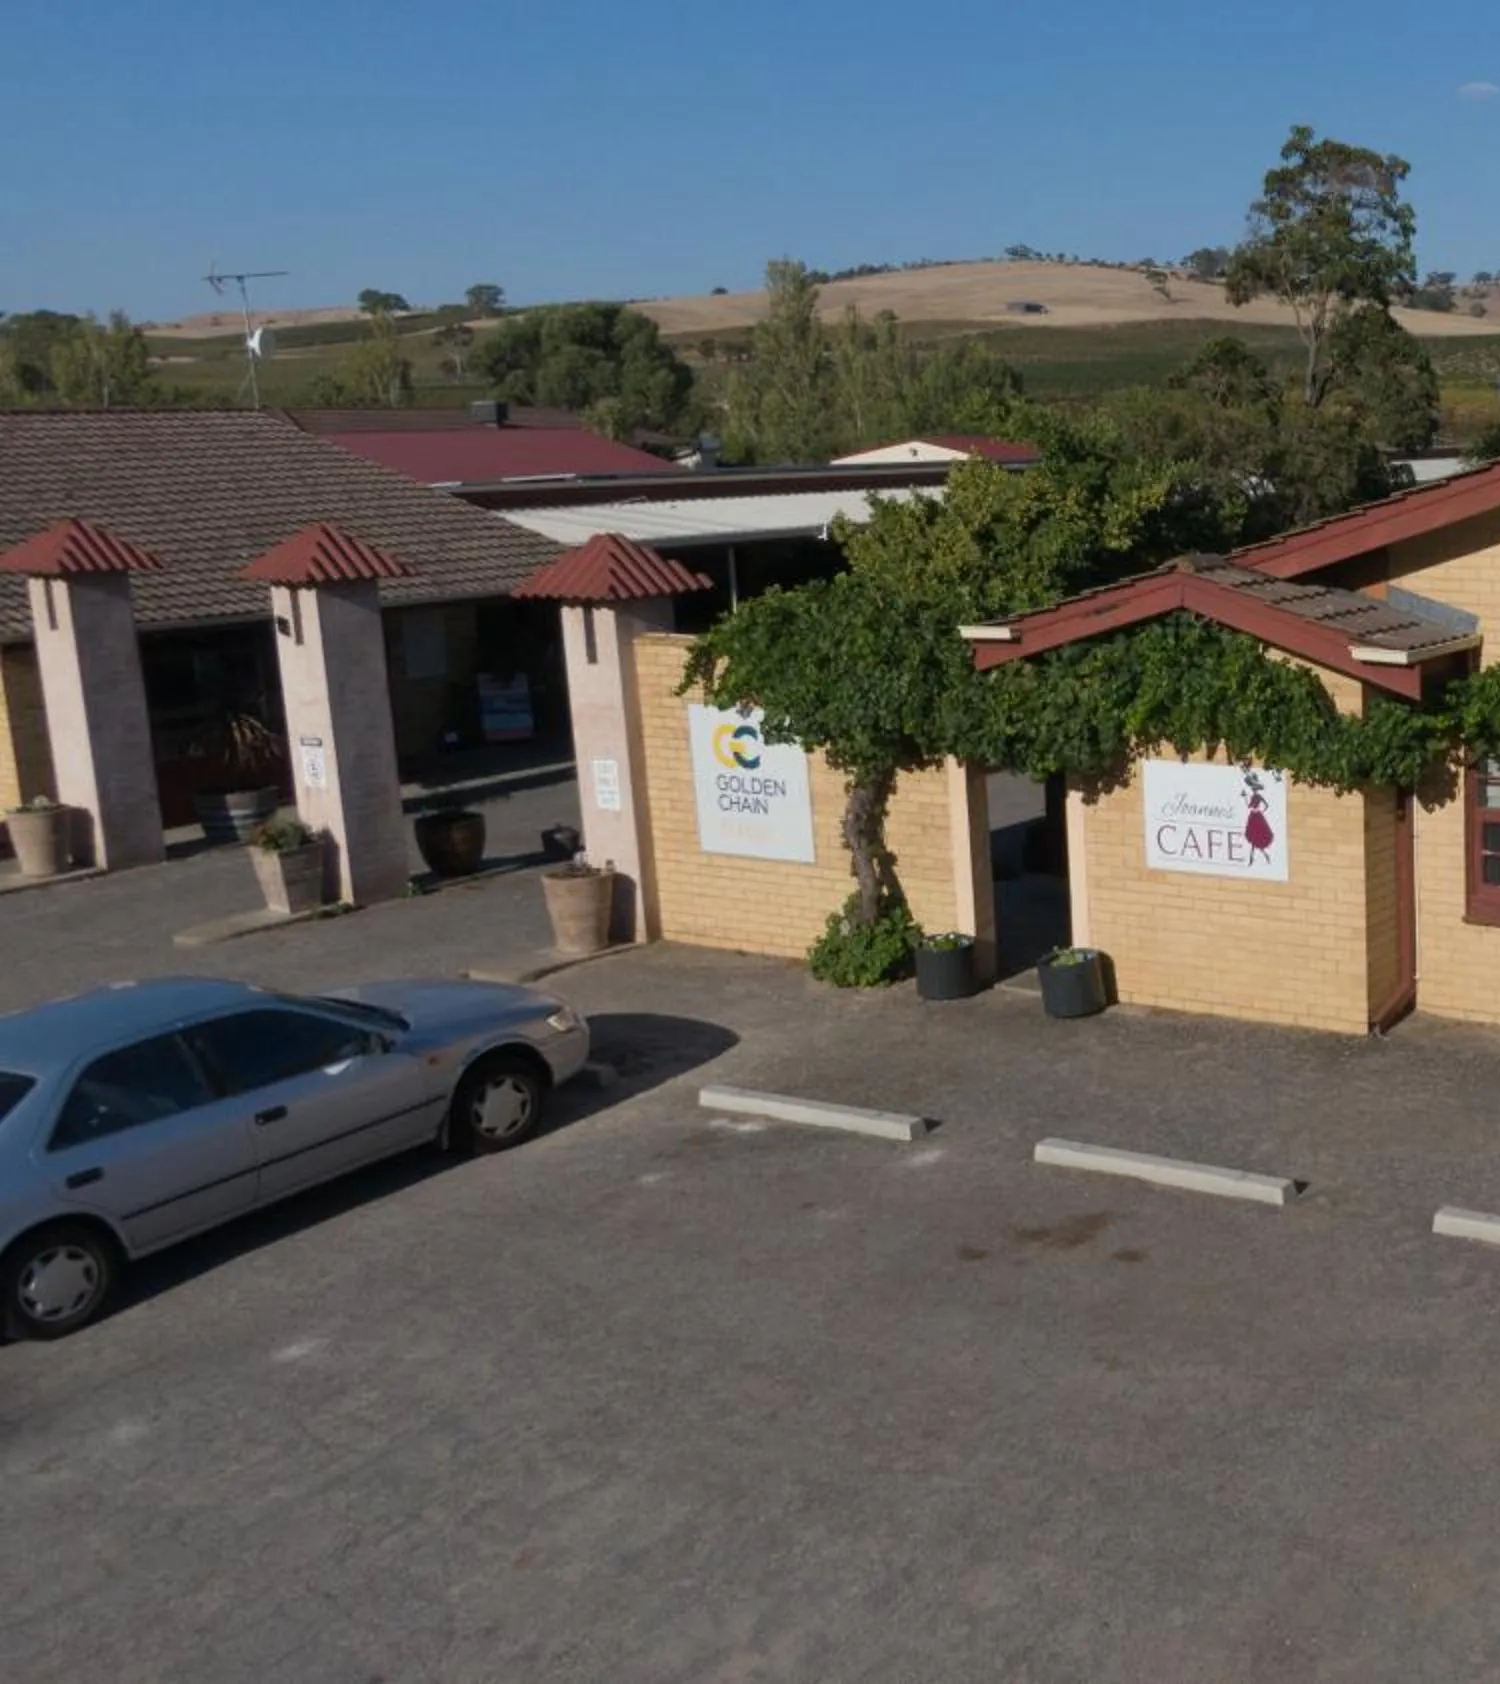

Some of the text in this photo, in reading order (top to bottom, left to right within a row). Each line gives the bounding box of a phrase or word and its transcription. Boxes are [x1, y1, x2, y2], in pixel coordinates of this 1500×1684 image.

[716, 774, 786, 796] GOLDEN
[718, 794, 769, 814] CHAIN
[1157, 824, 1244, 861] CAFE
